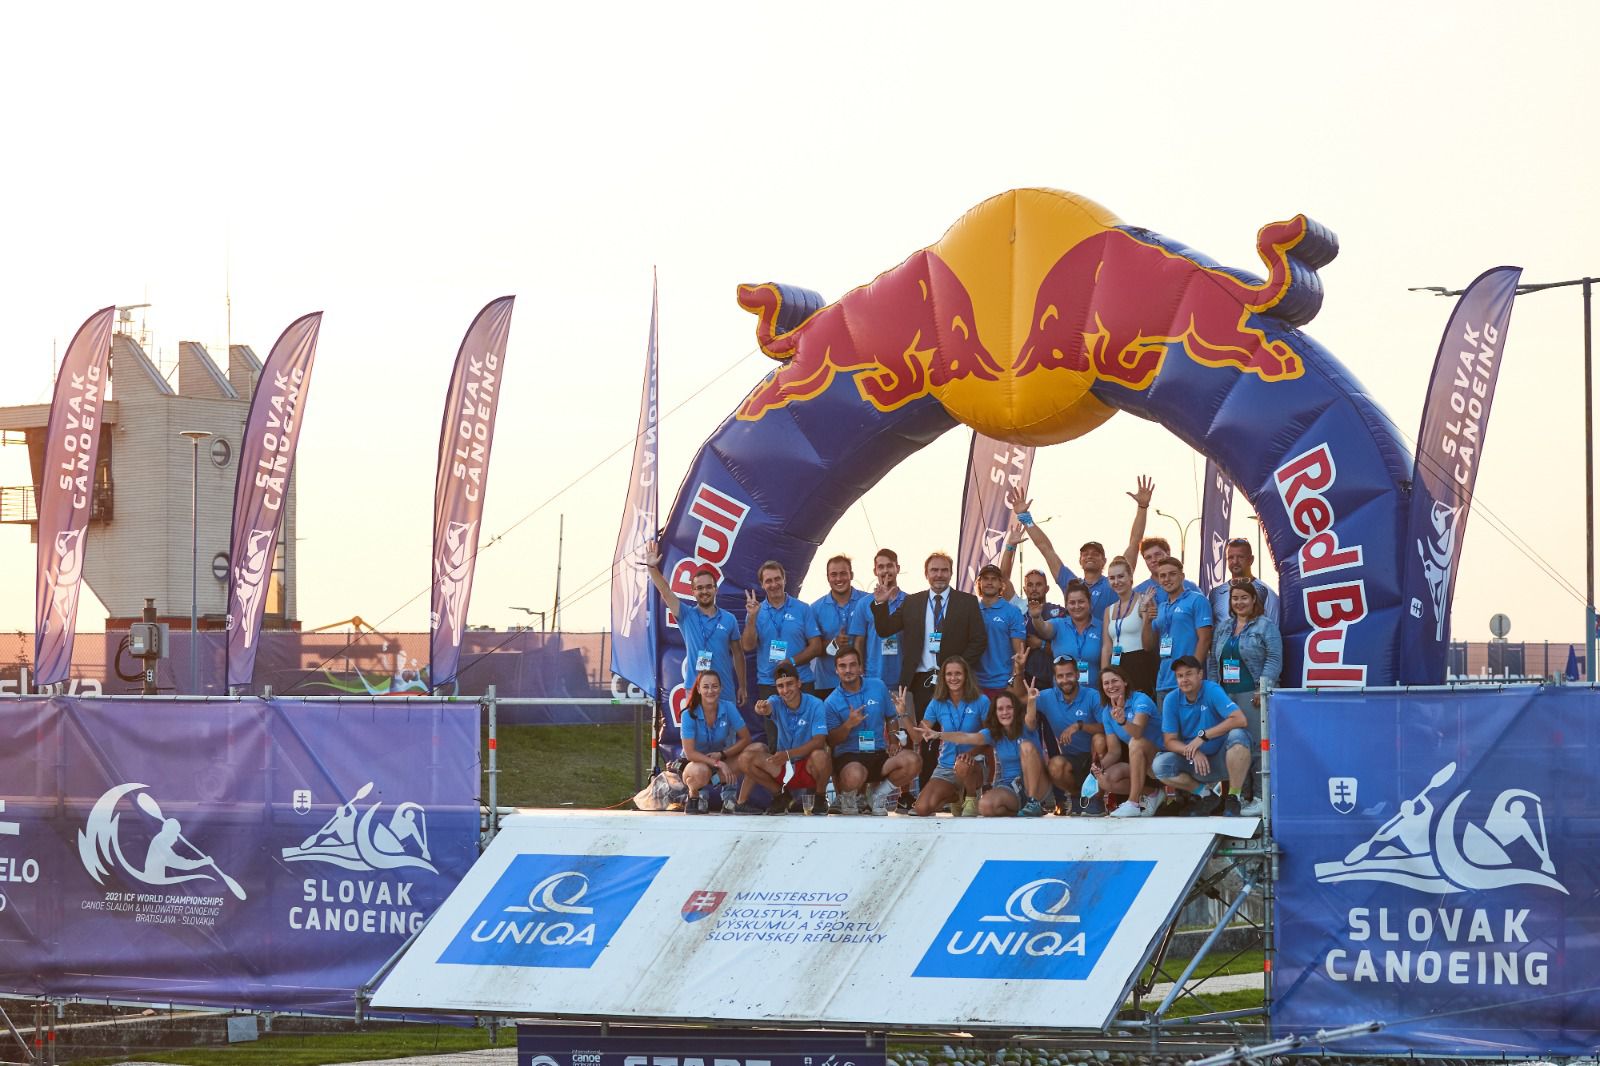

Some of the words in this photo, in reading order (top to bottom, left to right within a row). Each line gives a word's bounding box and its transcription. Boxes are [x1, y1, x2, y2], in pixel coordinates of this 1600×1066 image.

[1442, 322, 1480, 455] SLOVAK
[1454, 323, 1499, 486] CANOEING
[60, 371, 85, 491] SLOVAK
[256, 370, 289, 488] SLOVAK
[454, 355, 483, 479] SLOVAK
[465, 352, 498, 502] CANOEING
[72, 366, 100, 509] CANOEING
[263, 367, 304, 511] CANOEING
[1274, 442, 1363, 578] Red
[81, 900, 105, 910] CANOE
[106, 901, 134, 911] SLALOM
[135, 903, 140, 912] &
[142, 904, 184, 914] WILDWATER
[185, 906, 219, 916] CANOEING
[105, 892, 122, 901] 2021
[124, 893, 135, 901] ICF
[137, 893, 165, 903] WORLD
[165, 895, 224, 906] CHAMPIONSHIPS
[303, 878, 413, 906] SLOVAK
[734, 891, 849, 902] MINISTERSTVO
[135, 913, 176, 924] BRATISLAVA
[182, 915, 215, 926] SLOVAKIA
[471, 920, 596, 946] UNIQA
[705, 931, 800, 944] SLOVENSKEJ
[803, 933, 887, 943] REPUBLIKY
[798, 921, 808, 930] A
[1348, 907, 1531, 943] SLOVAK
[946, 931, 1086, 957] UNIQA
[1326, 949, 1548, 985] CANOEING
[572, 1054, 600, 1062] canoe
